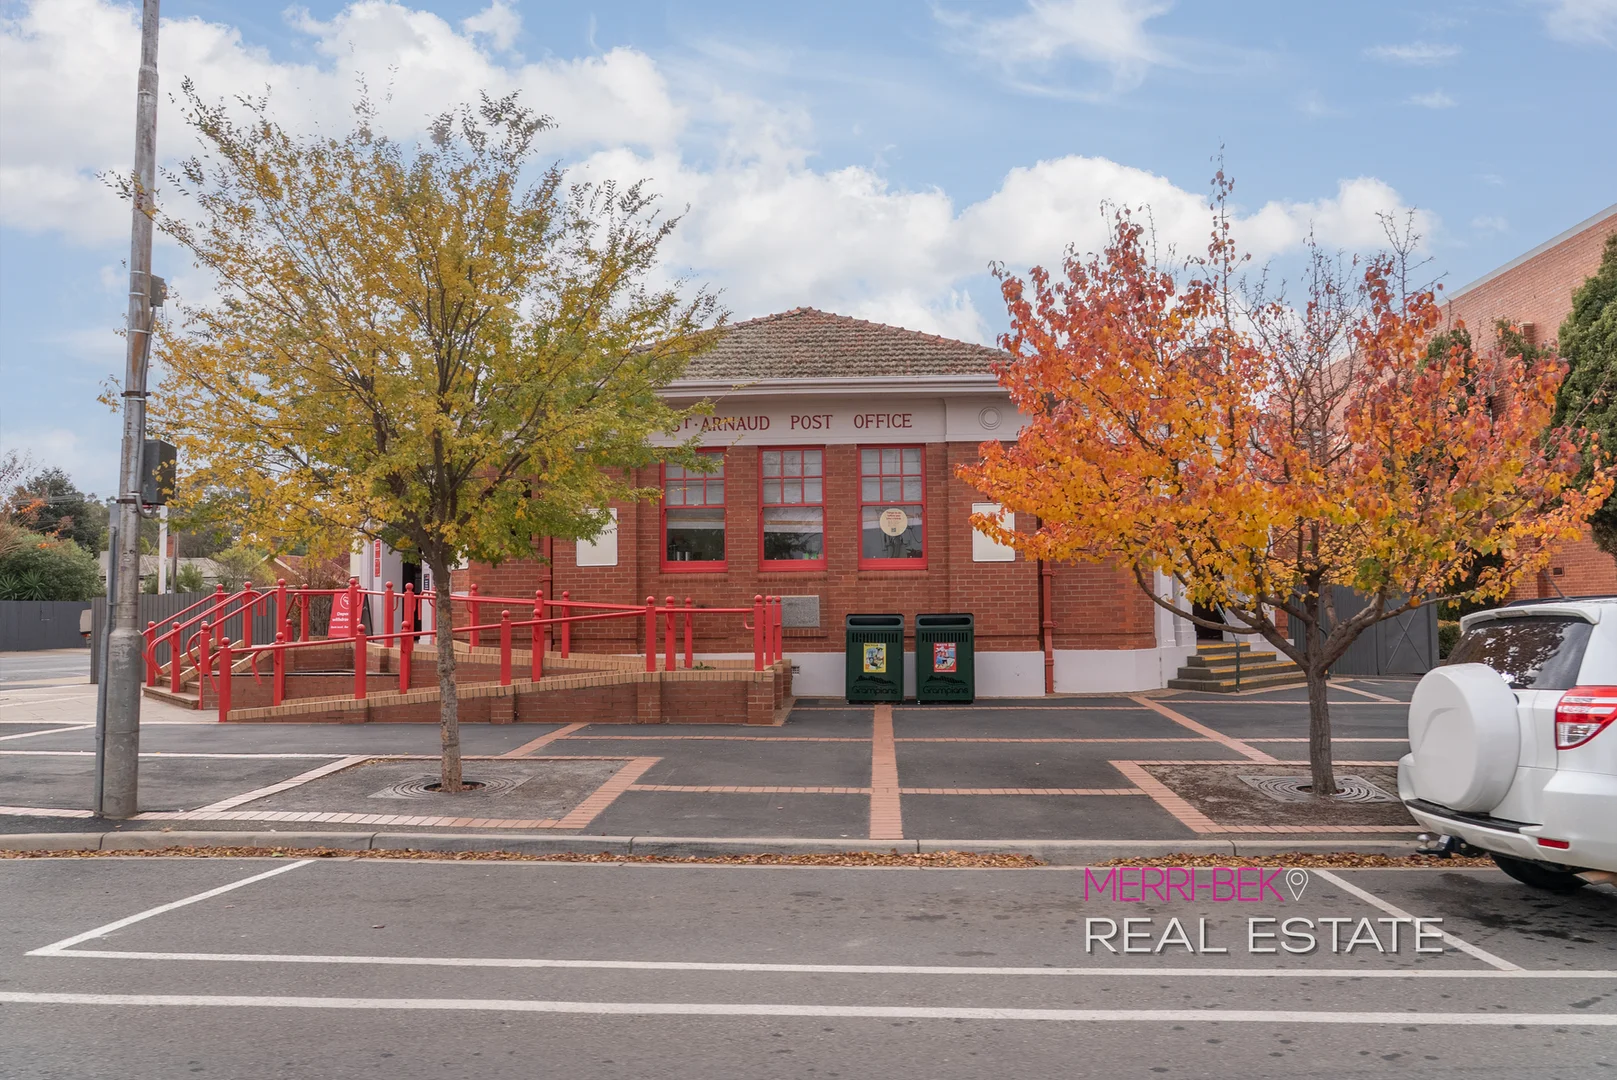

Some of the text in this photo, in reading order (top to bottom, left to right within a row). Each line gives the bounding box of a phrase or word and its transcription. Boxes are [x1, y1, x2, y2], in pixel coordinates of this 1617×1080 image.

[700, 415, 771, 432] ARNAUD
[790, 414, 834, 430] POST
[853, 413, 913, 429] OFFICE
[851, 685, 898, 696] Grampians
[922, 685, 969, 696] Grampians
